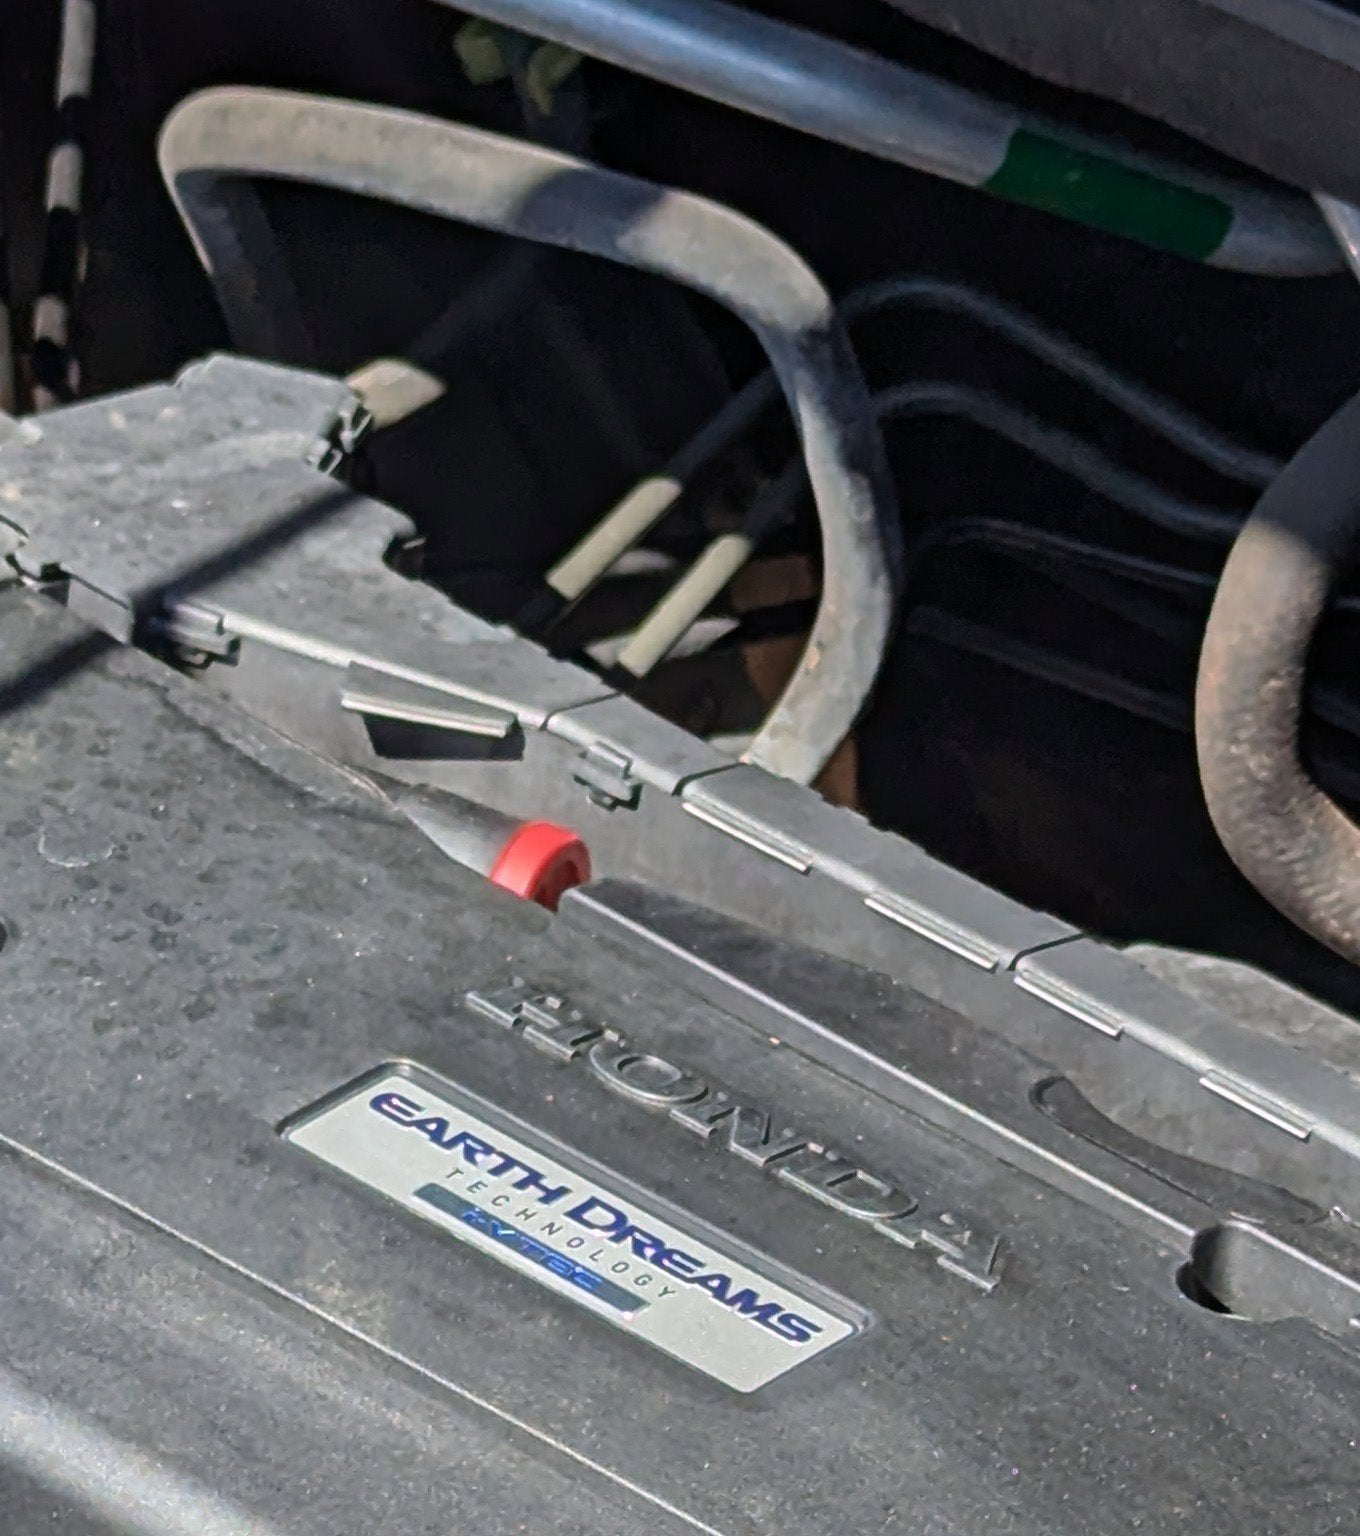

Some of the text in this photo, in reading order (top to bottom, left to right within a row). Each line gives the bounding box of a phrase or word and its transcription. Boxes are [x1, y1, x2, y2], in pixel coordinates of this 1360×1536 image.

[369, 1092, 823, 1344] EARTH DREAMS
[445, 1166, 676, 1298] TECHNOLOGY
[464, 977, 1001, 1292] HONDA
